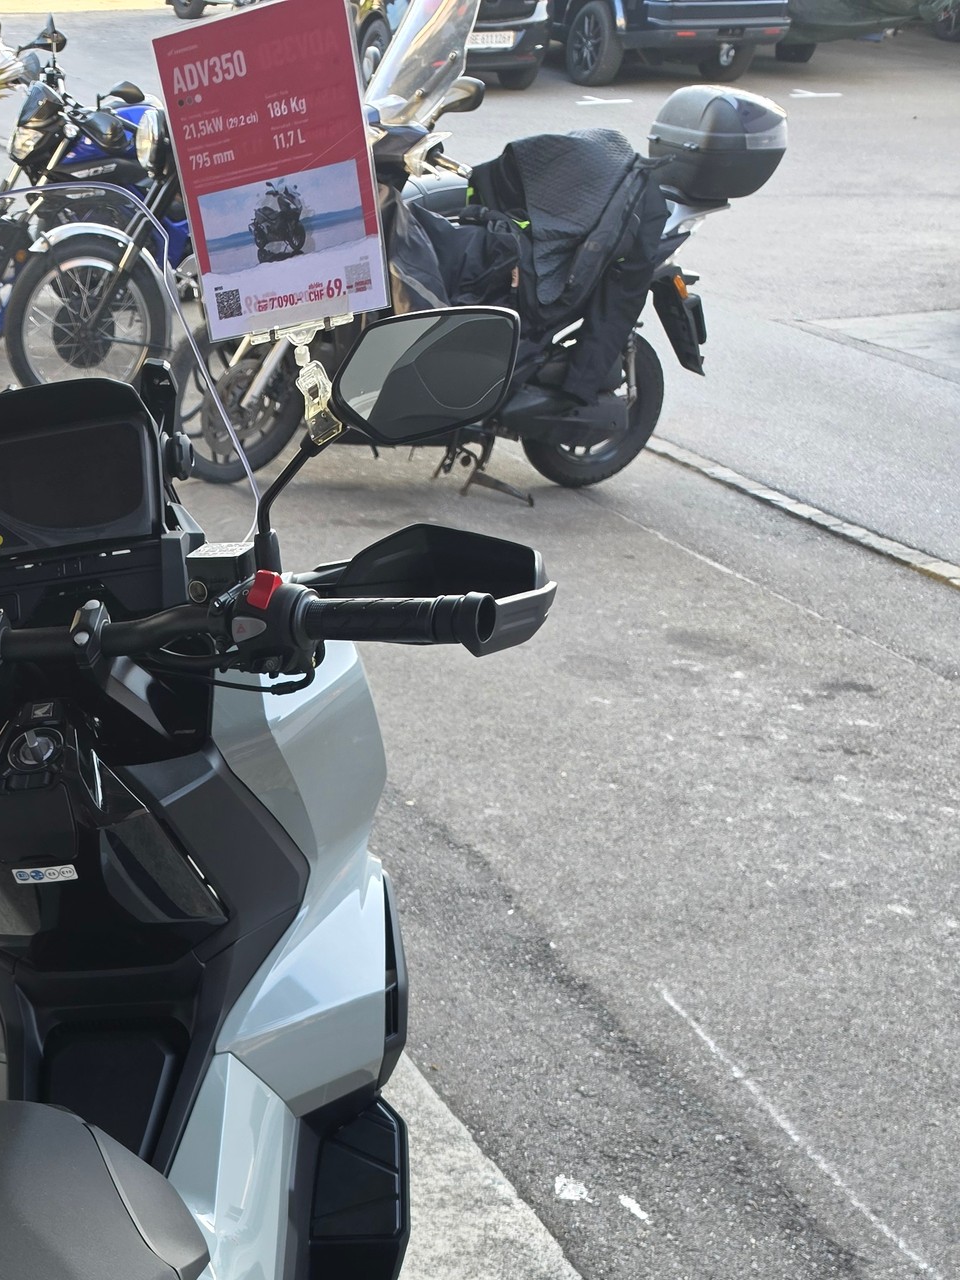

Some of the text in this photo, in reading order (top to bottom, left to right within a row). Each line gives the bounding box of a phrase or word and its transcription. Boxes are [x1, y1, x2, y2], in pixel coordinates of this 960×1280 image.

[173, 49, 247, 95] ADV350
[267, 96, 307, 118] 186 Kg
[183, 115, 224, 140] 21,5kW
[273, 128, 306, 150] 11,7 L
[189, 152, 210, 171] 795
[213, 149, 235, 164] mm
[308, 289, 325, 303] CHF
